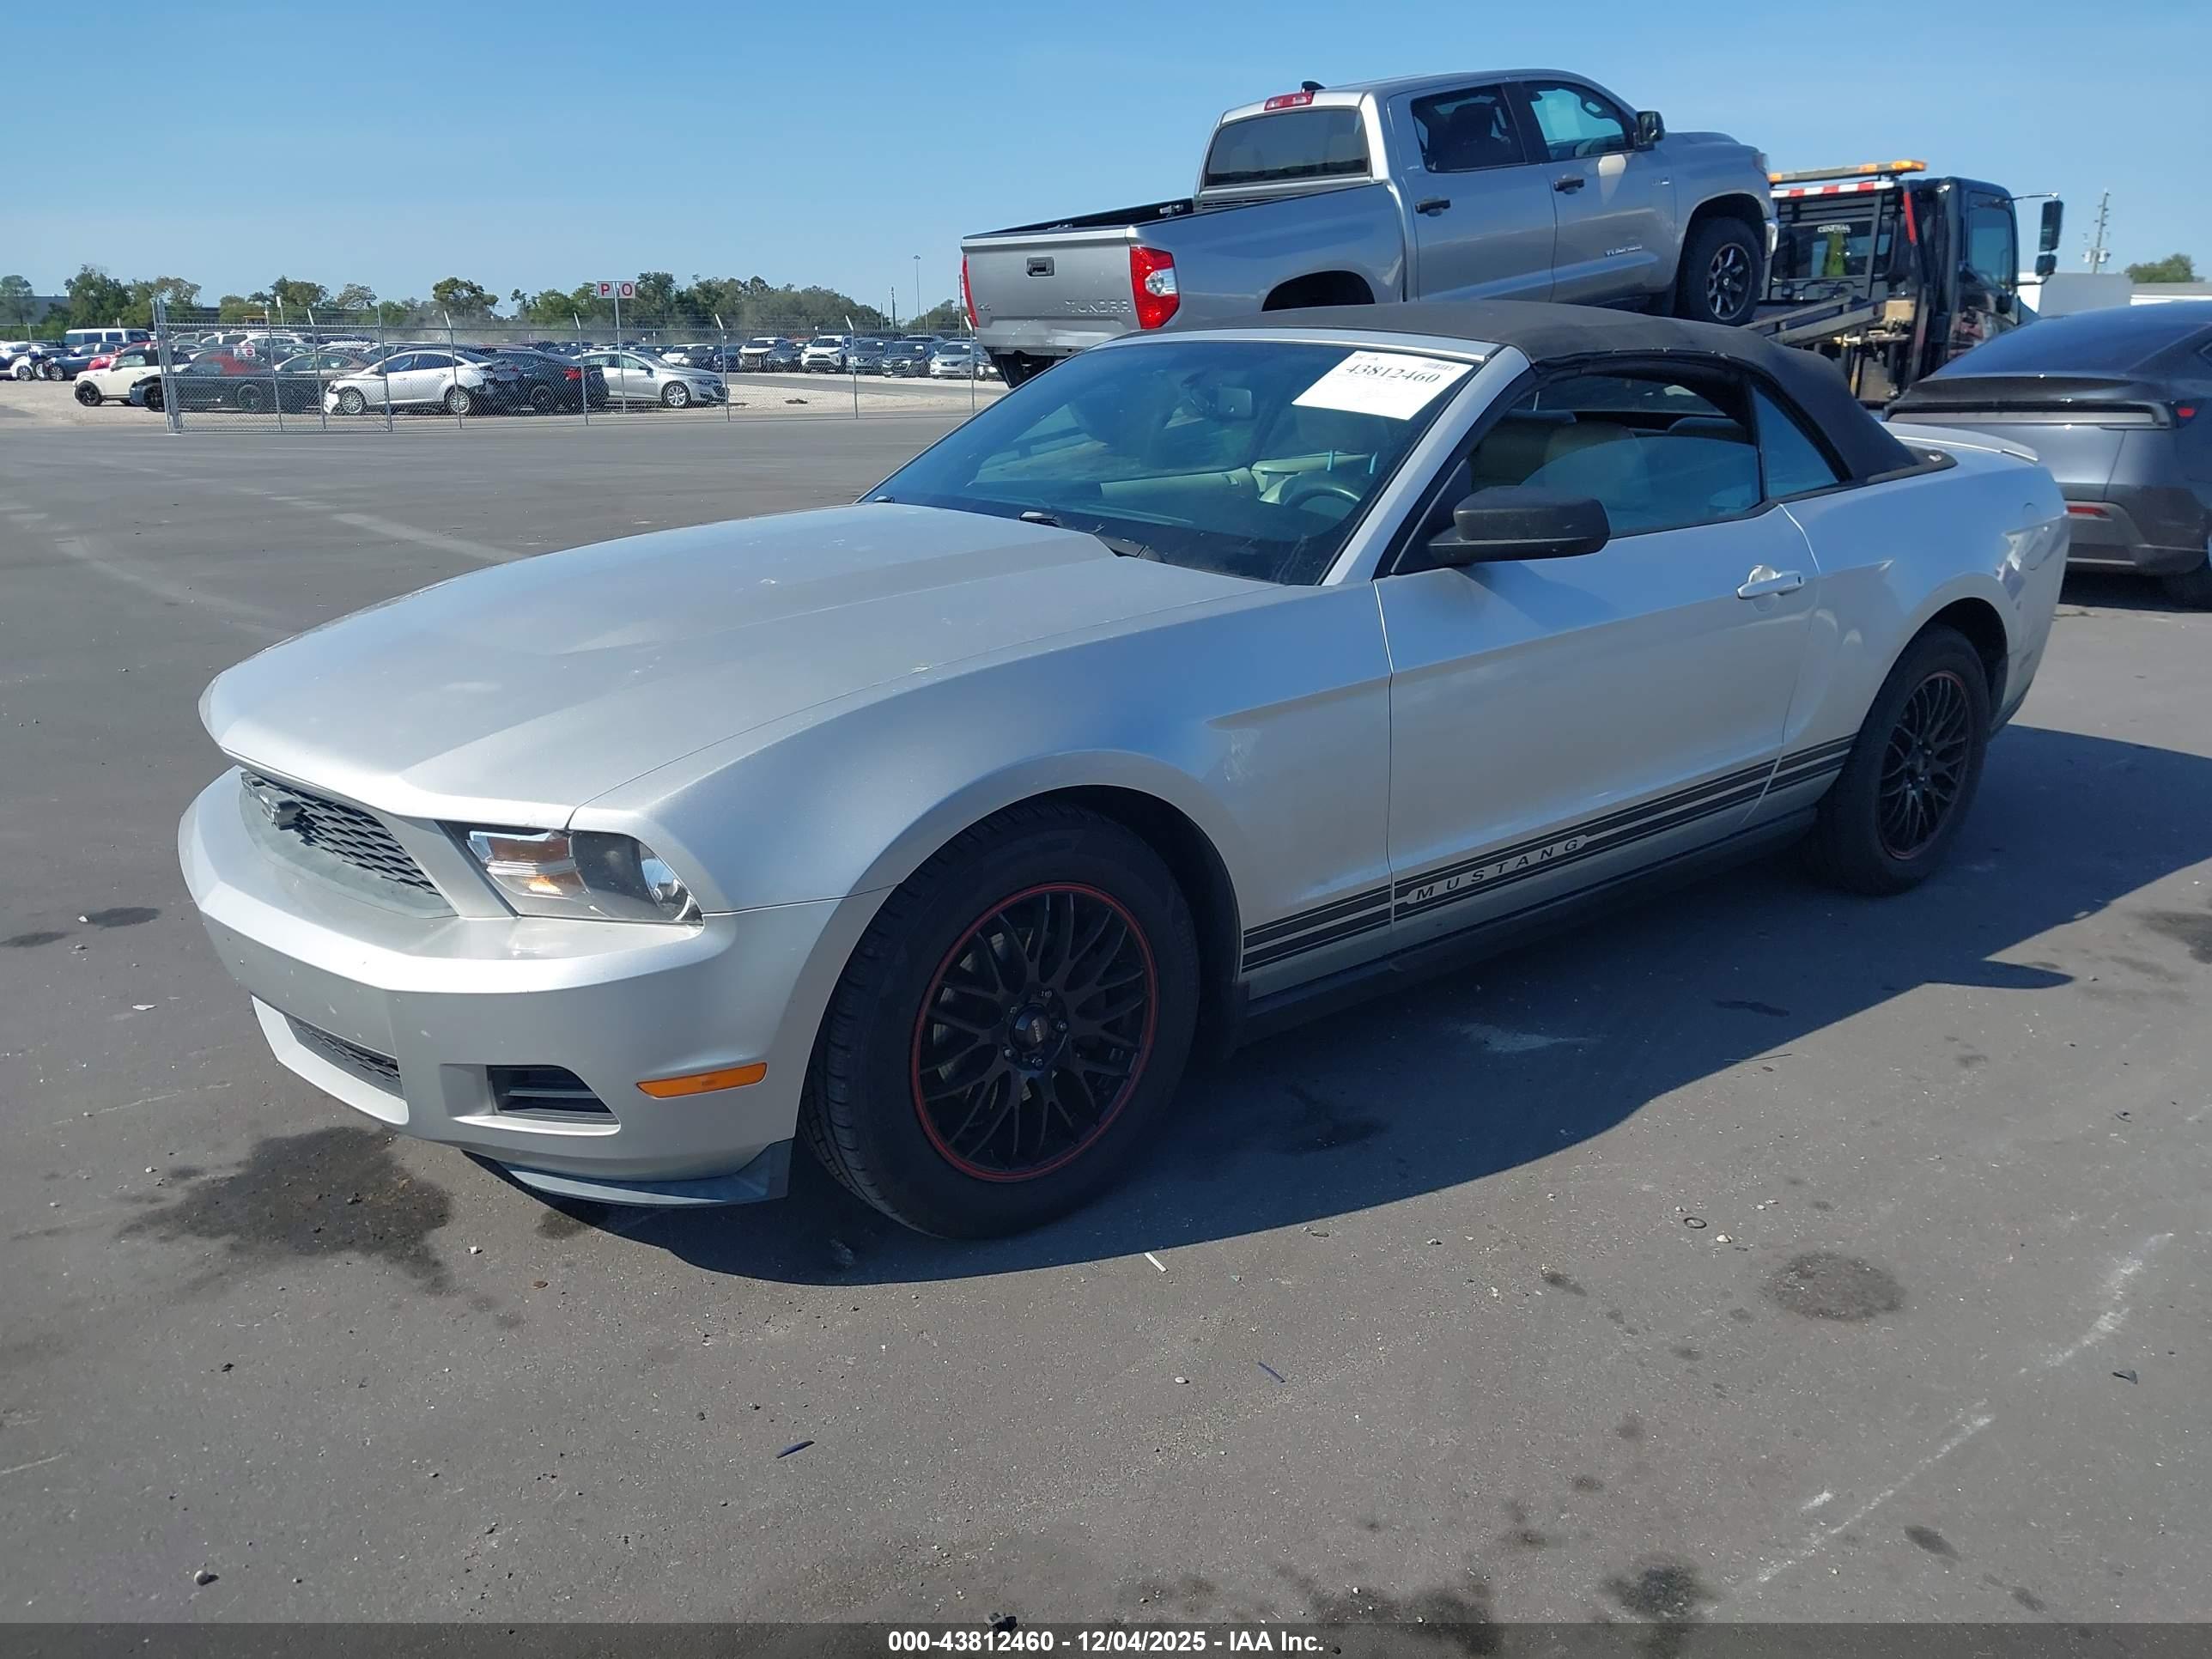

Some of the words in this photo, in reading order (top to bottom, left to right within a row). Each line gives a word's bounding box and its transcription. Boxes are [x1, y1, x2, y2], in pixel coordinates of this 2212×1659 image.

[600, 283, 610, 296] P
[1065, 300, 1132, 315] TUNDRA
[1346, 364, 1441, 384] 43812460
[1417, 838, 1578, 901] MUSTANG
